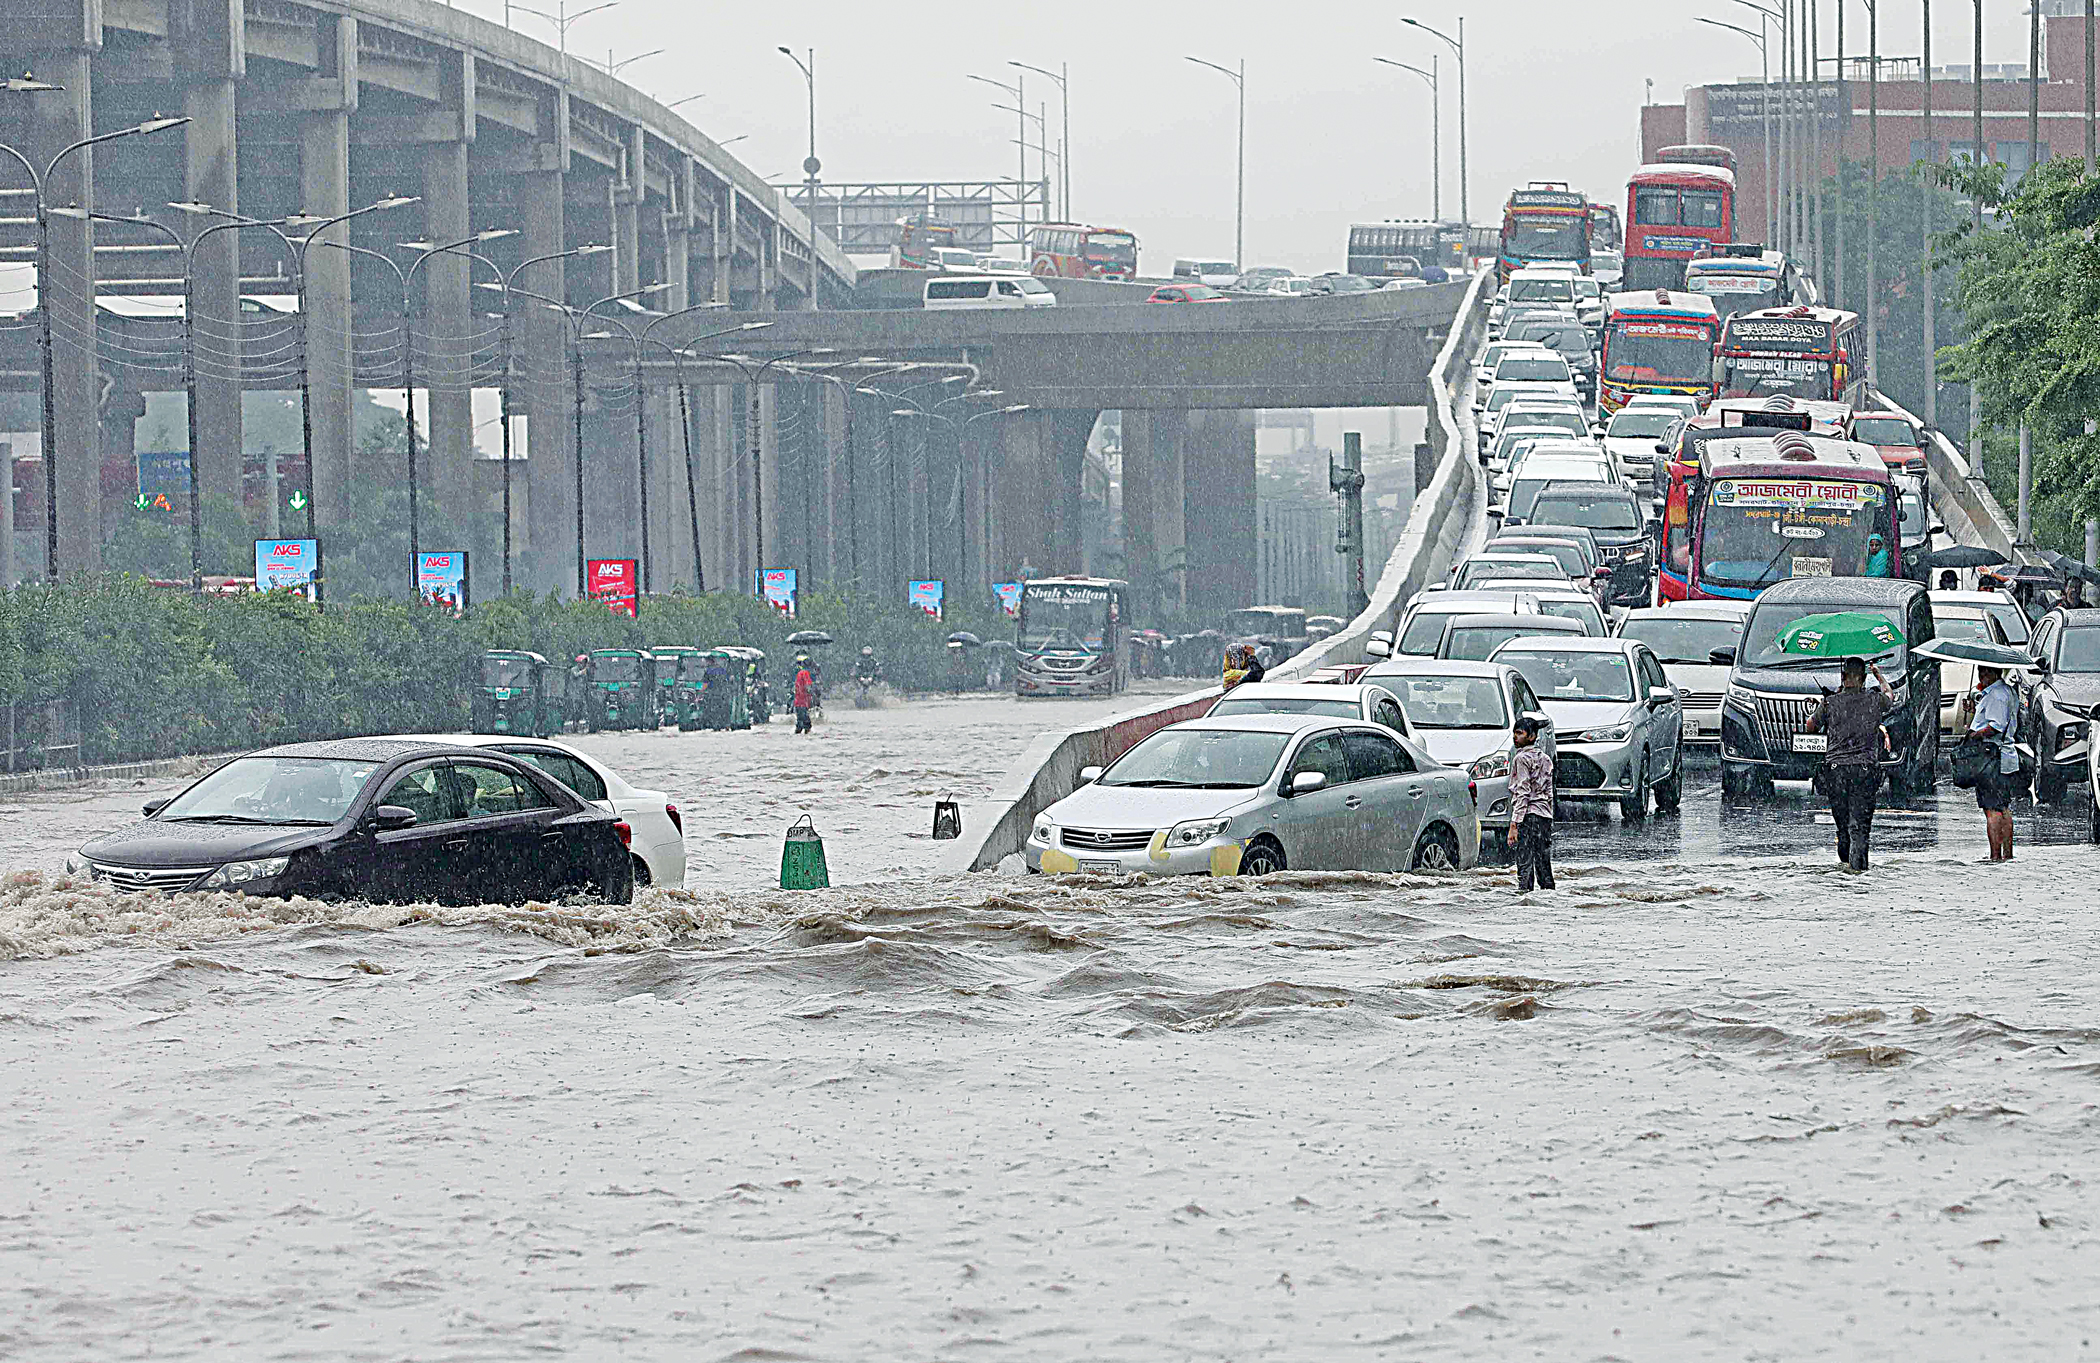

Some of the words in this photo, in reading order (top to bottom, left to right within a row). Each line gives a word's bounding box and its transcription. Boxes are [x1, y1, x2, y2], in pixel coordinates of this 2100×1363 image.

[1738, 482, 1813, 500] আজমেরী
[1817, 483, 1858, 502] গ্লোরী
[273, 544, 301, 556] AKS
[425, 556, 450, 567] AKS
[598, 563, 623, 575] AKS
[767, 572, 785, 581] AKS
[1025, 587, 1061, 599] Shah
[1063, 587, 1108, 600] Sultan
